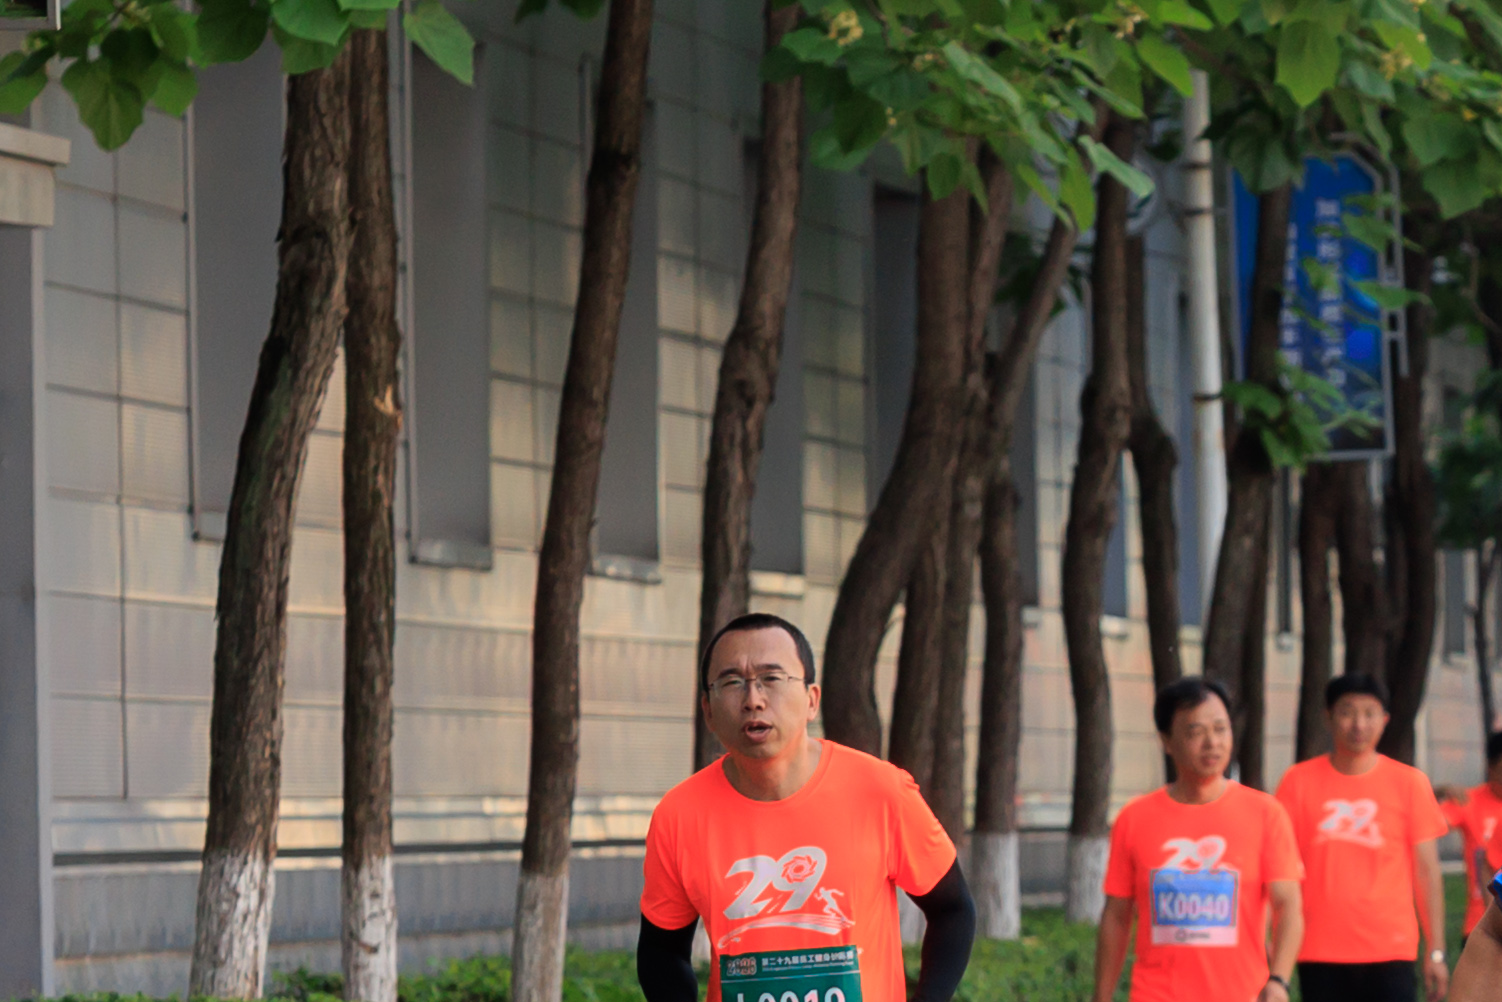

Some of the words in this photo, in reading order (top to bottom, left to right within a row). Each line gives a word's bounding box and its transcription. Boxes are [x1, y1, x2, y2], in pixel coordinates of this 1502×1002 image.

[1320, 799, 1378, 830] 29
[1161, 835, 1227, 870] 29
[723, 846, 827, 920] 29
[1158, 892, 1230, 921] K0040
